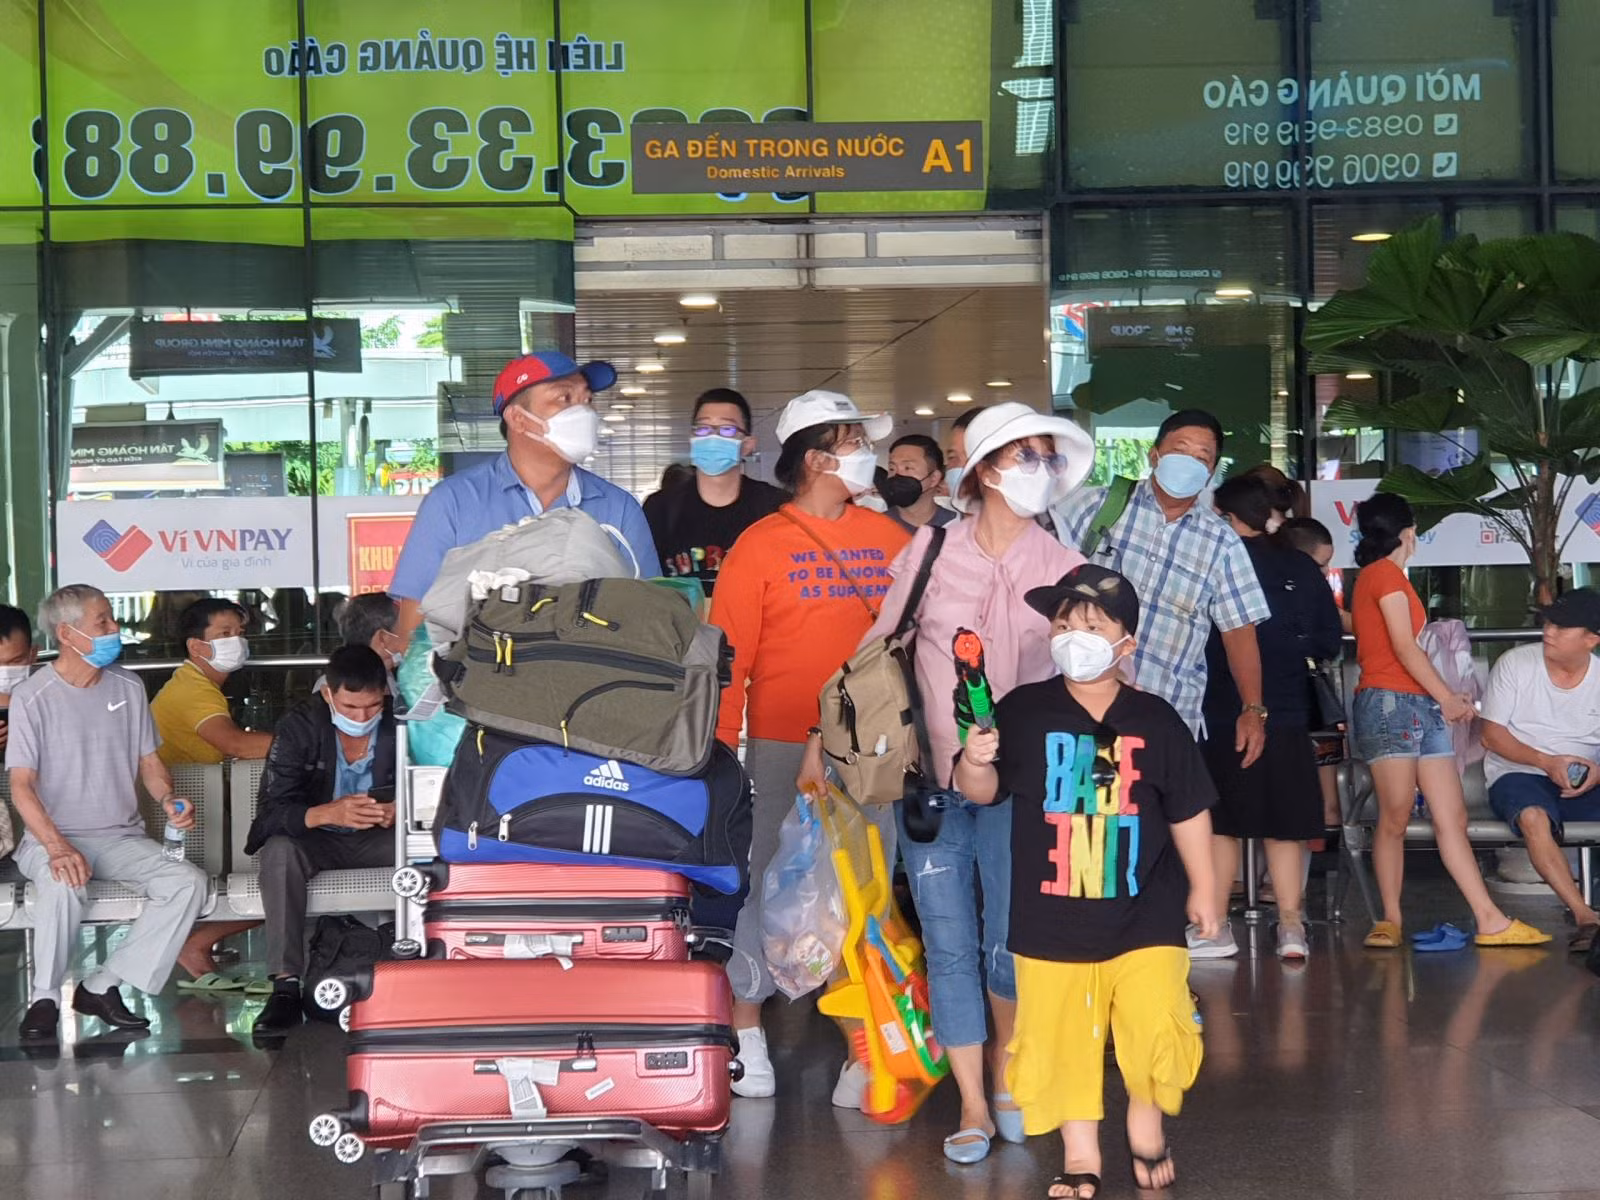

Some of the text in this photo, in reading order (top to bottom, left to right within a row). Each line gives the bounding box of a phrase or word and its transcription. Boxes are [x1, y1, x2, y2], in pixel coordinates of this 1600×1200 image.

[645, 132, 904, 159] GA ĐẾN TRONG NƯỚC
[921, 138, 972, 173] A1
[707, 165, 845, 179] Domestic Arrivals
[158, 528, 293, 552] Ví VNPAY
[222, 559, 240, 570] gia
[359, 547, 394, 571] KHU
[790, 551, 817, 563] WE
[788, 566, 889, 584] TO BE KNOW
[801, 585, 822, 599] AS
[583, 773, 630, 792] adidas
